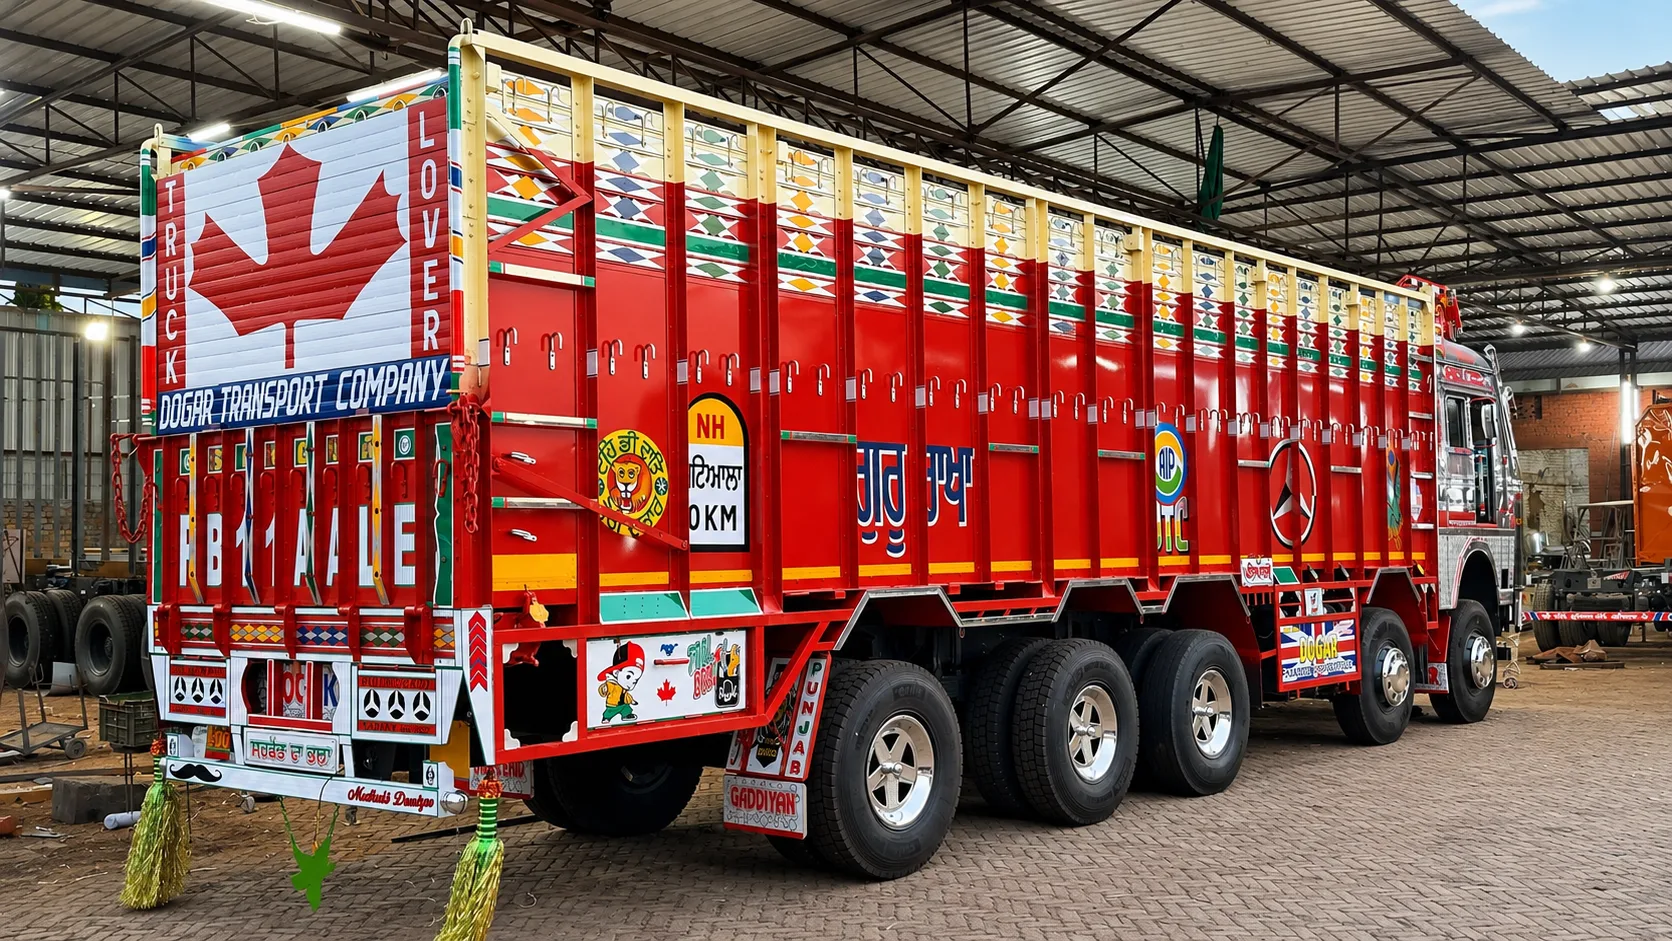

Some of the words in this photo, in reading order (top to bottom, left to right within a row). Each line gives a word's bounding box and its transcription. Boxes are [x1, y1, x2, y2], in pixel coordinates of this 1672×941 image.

[419, 111, 440, 351] LOVER
[165, 180, 178, 384] TRUCK
[159, 387, 214, 431] DOGAR
[220, 374, 329, 424] TRANSPORT
[335, 358, 449, 411] COMPANY
[696, 413, 725, 440] NH
[689, 454, 743, 492] ਟਿਆਲਾ
[704, 504, 737, 531] KM
[789, 661, 822, 776] PUNJAB
[730, 784, 798, 816] GADDIYAN
